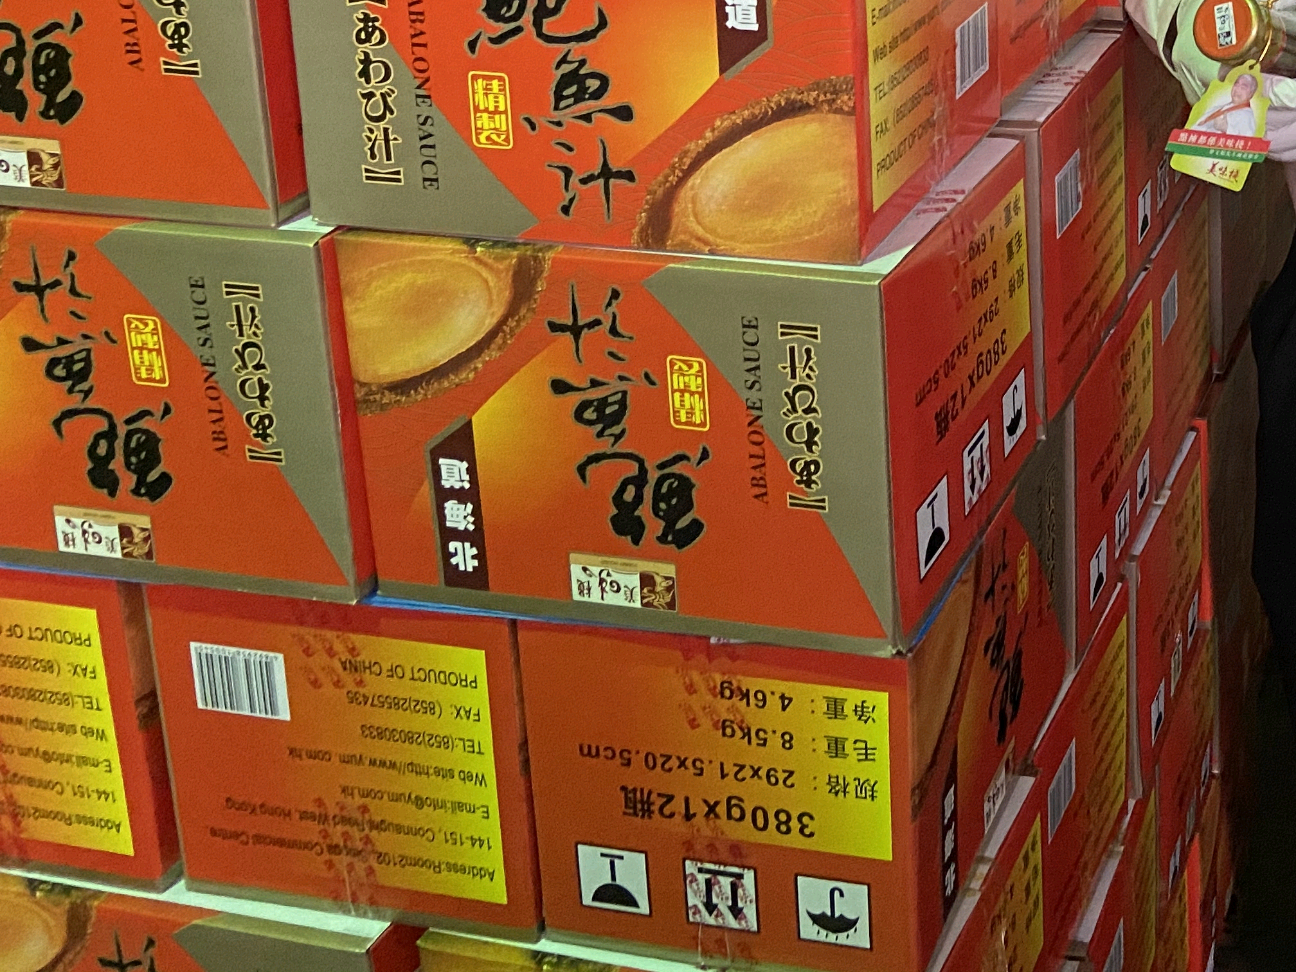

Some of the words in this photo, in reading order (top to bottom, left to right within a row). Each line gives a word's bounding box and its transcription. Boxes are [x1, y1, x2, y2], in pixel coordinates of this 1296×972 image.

[473, 78, 509, 146] 精製
[415, 114, 440, 191] SAUCE
[968, 223, 996, 263] 4.6kg
[971, 260, 998, 301] 8.5kg
[188, 275, 216, 349] SAUCE
[741, 315, 762, 391] SAUCE
[914, 296, 1000, 410] 29x21.5x20.5cm
[201, 354, 229, 457] ABALONE
[546, 281, 710, 550] 鮑魚汁
[746, 397, 769, 505] ABALONE
[438, 458, 479, 572] 北海道
[6, 623, 23, 639] OF
[28, 625, 92, 647] PRODUCT
[67, 662, 97, 679] FAX:
[338, 658, 383, 676] CHINA
[386, 663, 405, 678] OF
[410, 667, 478, 689] PRODUCT
[345, 690, 443, 720] (852)28557435
[449, 705, 481, 722] FAX:
[718, 680, 793, 712] 4.6kg
[80, 725, 107, 742] Web
[360, 724, 485, 755] TEL:(852)28030833
[719, 718, 795, 751] 8.5kg
[458, 769, 488, 787] Web
[577, 742, 796, 790] 29x21.5x20.5cm
[619, 784, 815, 839] 380gx12瓶
